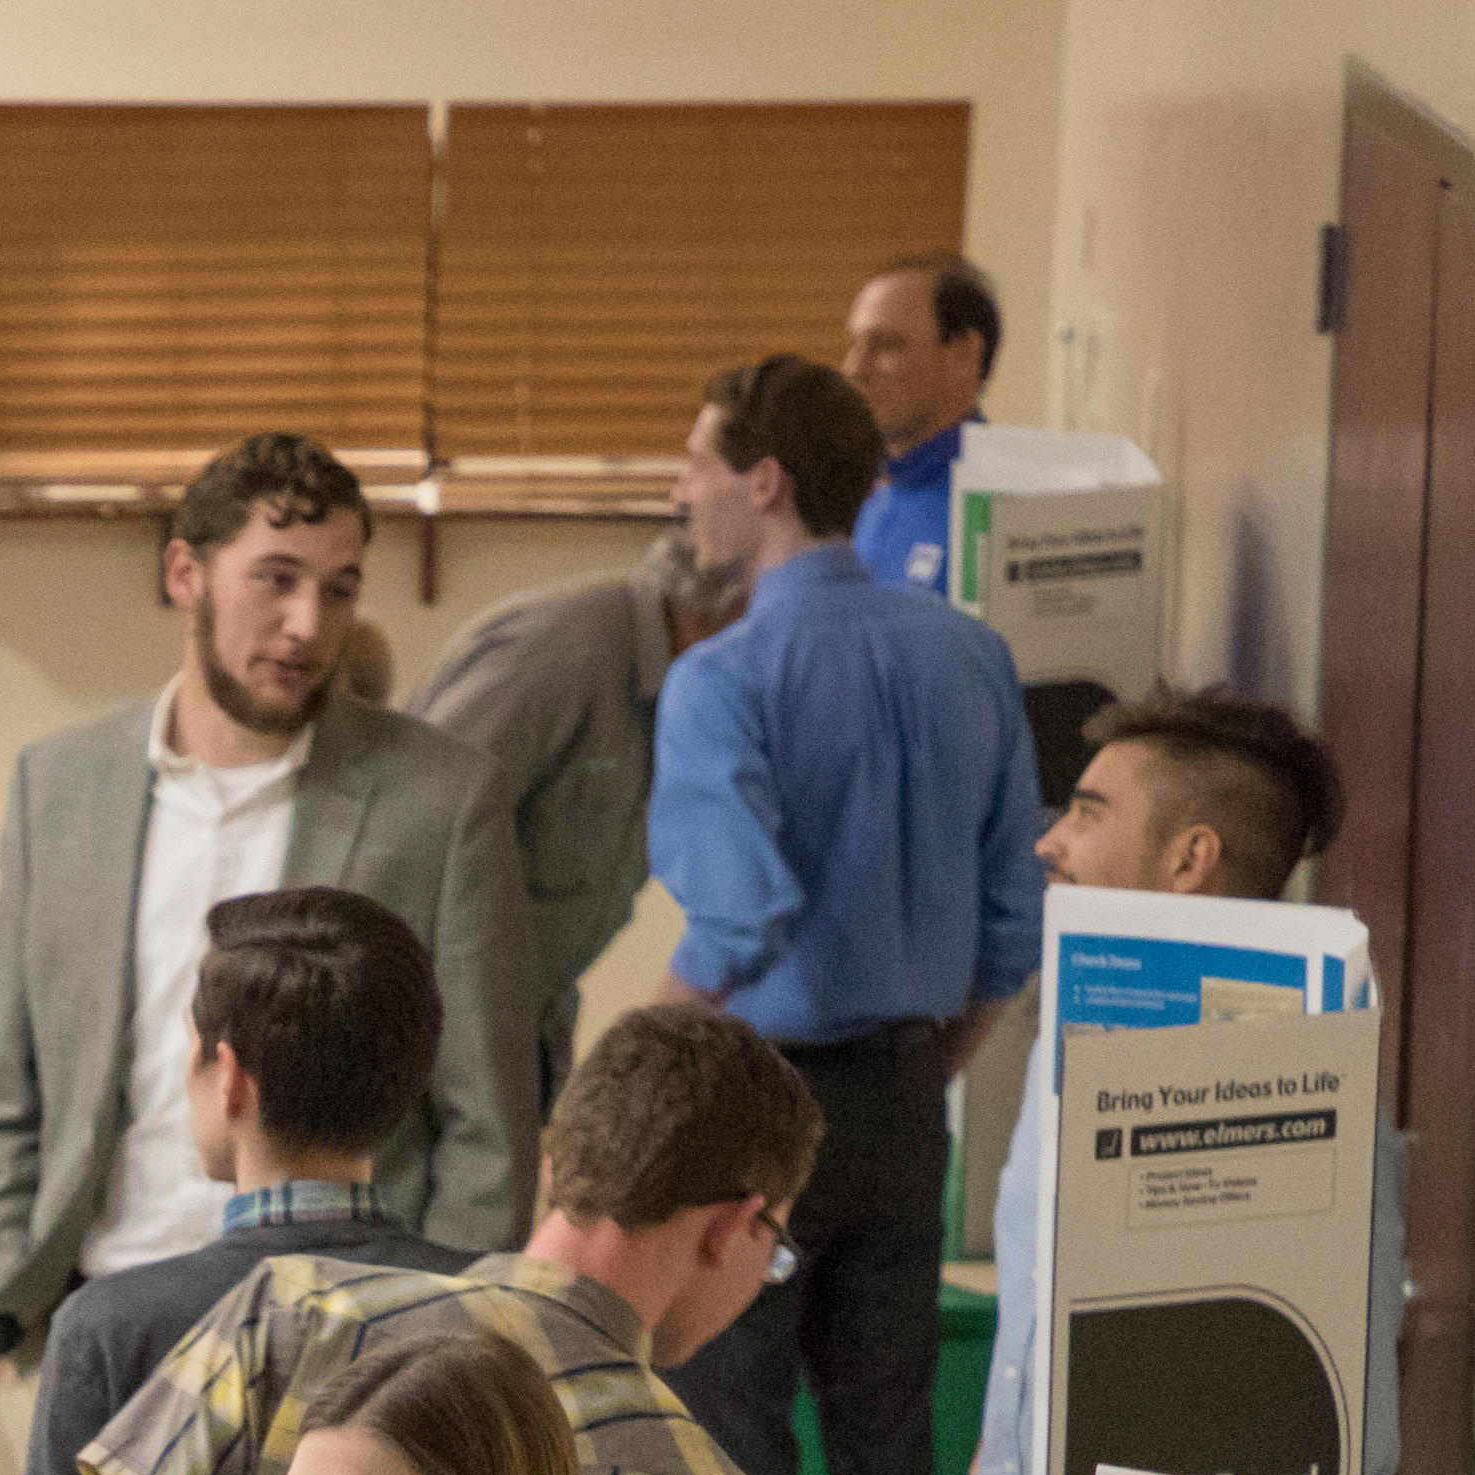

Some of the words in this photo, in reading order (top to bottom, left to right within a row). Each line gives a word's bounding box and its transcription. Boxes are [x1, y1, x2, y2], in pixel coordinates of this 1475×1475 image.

[1097, 1090, 1154, 1113] Bring
[1159, 1085, 1210, 1106] Your
[1216, 1080, 1273, 1102] Ideas
[1277, 1077, 1298, 1095] to
[1303, 1071, 1340, 1093] Life
[1140, 1118, 1327, 1151] www.elmers.com
